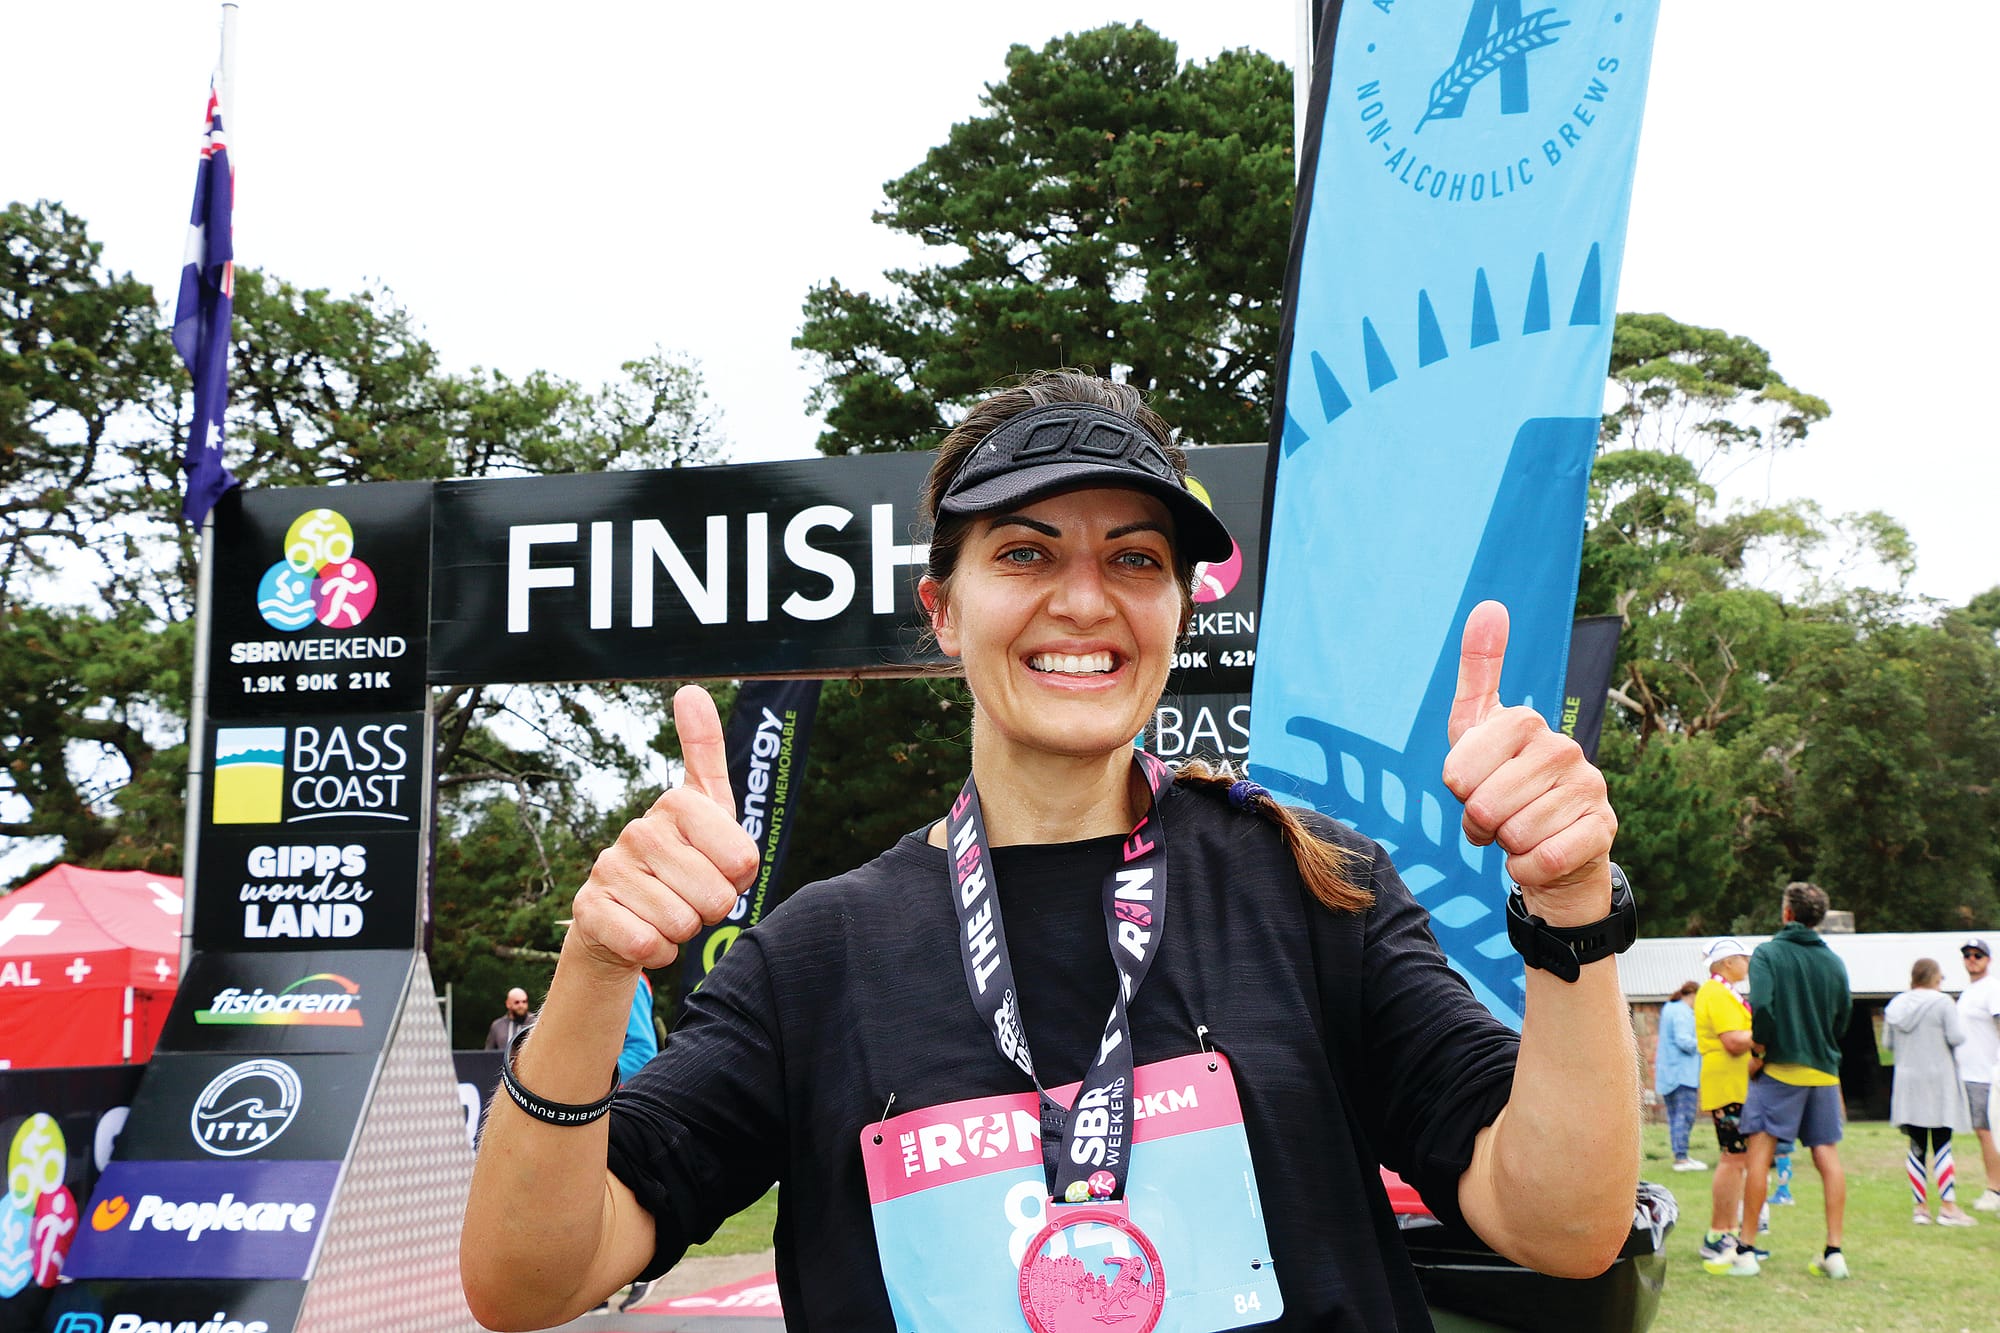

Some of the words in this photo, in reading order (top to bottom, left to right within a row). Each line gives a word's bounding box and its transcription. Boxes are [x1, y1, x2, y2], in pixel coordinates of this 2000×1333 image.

[1357, 80, 1534, 201] NON-ALCOHOLIC
[1542, 56, 1620, 166] BREWS
[507, 503, 931, 633] FINISH
[242, 675, 286, 694] 1.9K
[296, 673, 338, 692] 90K
[348, 671, 391, 690] 21K
[293, 724, 408, 772] BASS
[774, 710, 797, 804] MEMORABLE
[292, 774, 406, 809] COAST
[764, 807, 785, 864] EVENTS
[247, 844, 367, 878] GIPPS
[239, 870, 374, 902] wonder
[749, 867, 771, 925] MAKING
[244, 903, 364, 938] LAND
[967, 898, 1001, 995] THE
[209, 987, 354, 1015] fisiocrem
[204, 1122, 268, 1141] ITTA
[529, 1103, 555, 1120] RUN
[558, 1110, 590, 1122] BIKE
[1071, 1080, 1114, 1168] SBR
[1105, 1076, 1126, 1168] WEEKEND
[902, 1131, 922, 1178] THE
[918, 1109, 1044, 1173] RUN
[129, 1193, 317, 1242] Peoplecare
[1233, 1291, 1262, 1314] 84
